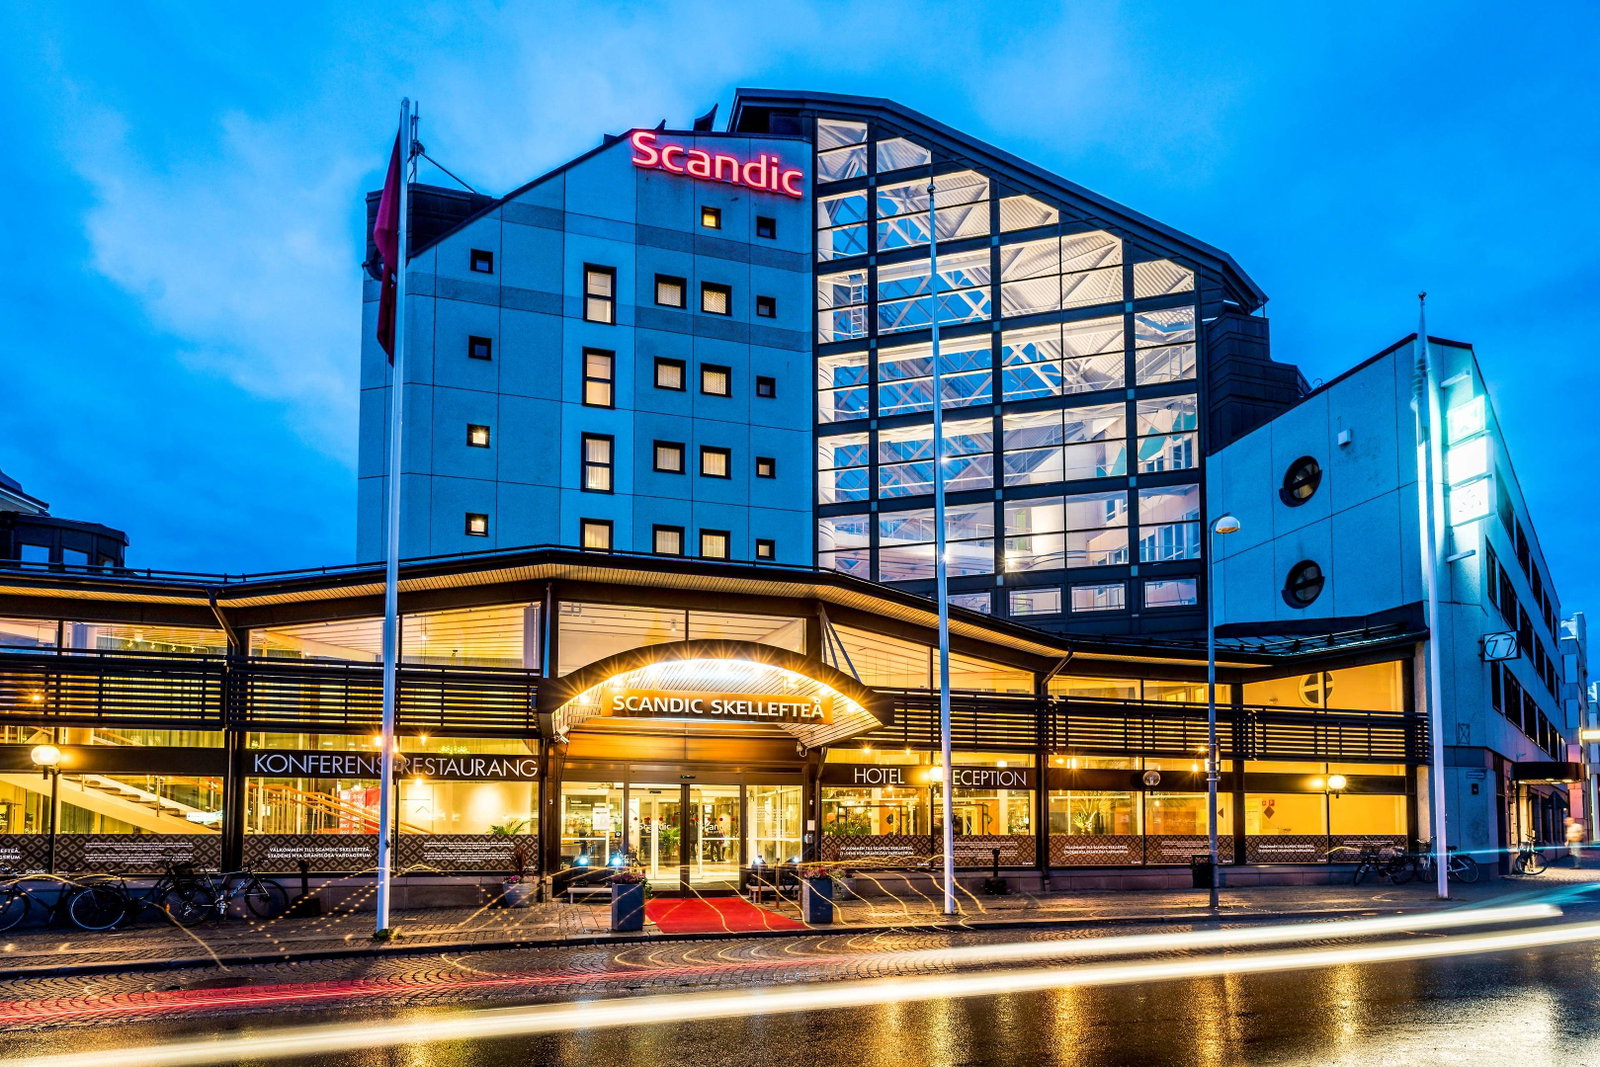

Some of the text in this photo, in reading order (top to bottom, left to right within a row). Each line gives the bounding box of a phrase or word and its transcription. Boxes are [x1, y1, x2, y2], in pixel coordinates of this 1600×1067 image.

[631, 131, 803, 196] Scandic
[612, 695, 825, 718] SCANDIC SKELLEFTEÅ
[854, 767, 1027, 786] HOTEL ECEPTION
